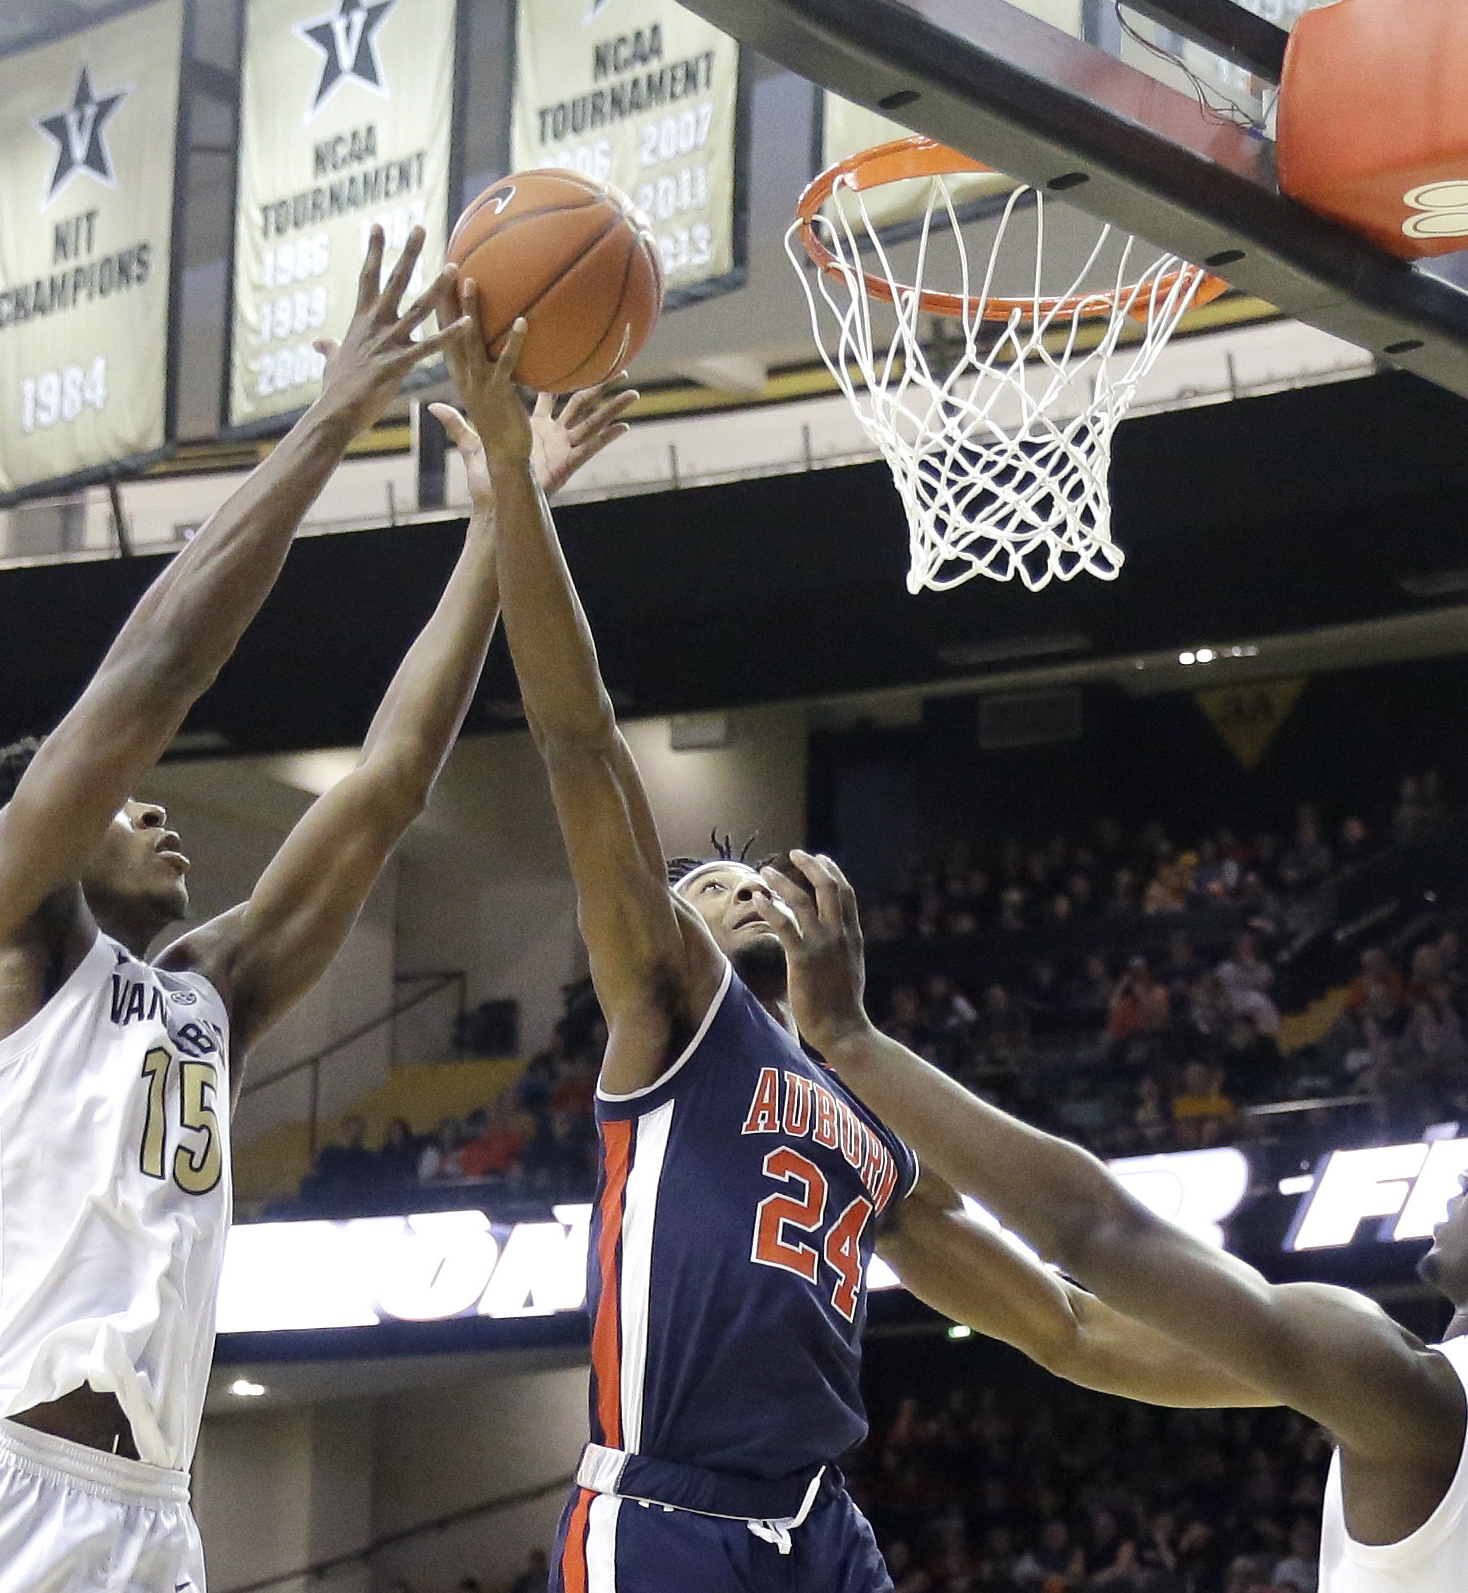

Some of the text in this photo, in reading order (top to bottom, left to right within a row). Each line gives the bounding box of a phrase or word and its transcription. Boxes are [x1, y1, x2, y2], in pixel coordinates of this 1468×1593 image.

[593, 21, 662, 84] NCAA
[539, 49, 715, 146] TOURNAMENT
[640, 101, 714, 168] 2007
[315, 125, 376, 177] NCAA
[54, 208, 99, 264] NIT
[262, 151, 424, 238] TOURNAMENT
[21, 355, 107, 435] 1984
[140, 1046, 223, 1196] 15
[740, 1066, 899, 1218] AUBURN
[750, 1145, 874, 1324] 24
